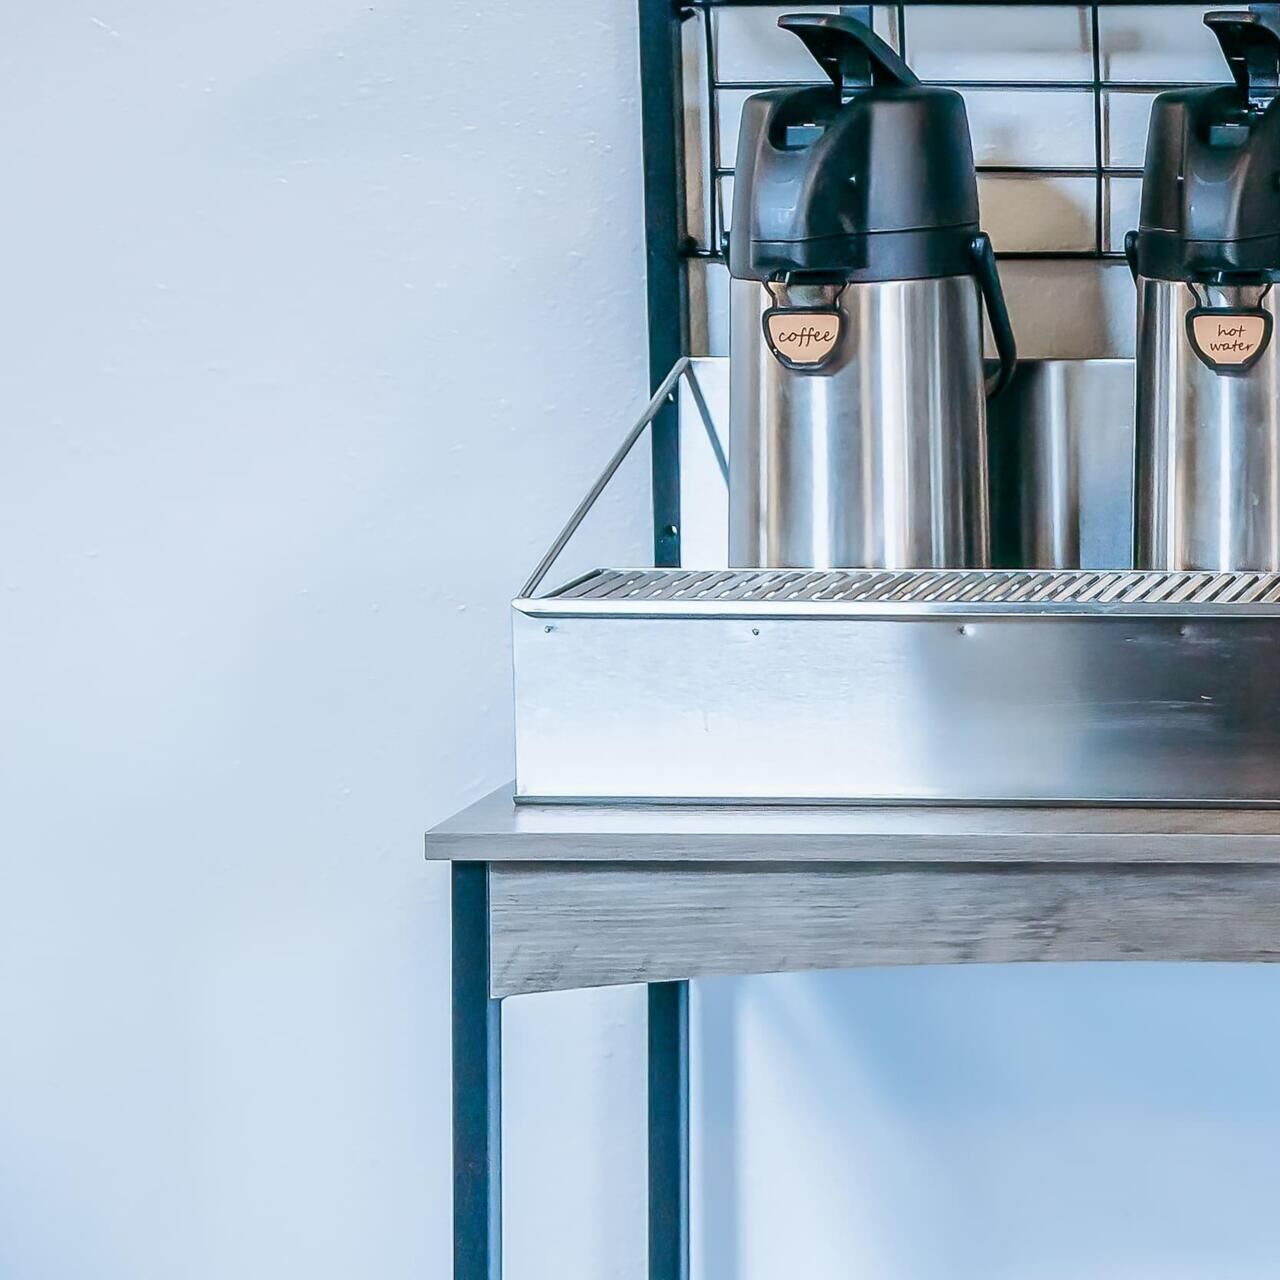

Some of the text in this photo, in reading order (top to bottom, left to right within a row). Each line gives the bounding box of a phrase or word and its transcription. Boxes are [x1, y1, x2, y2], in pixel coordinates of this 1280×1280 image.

[778, 326, 836, 348] coffee
[1217, 323, 1247, 337] hot
[1209, 339, 1254, 352] water
